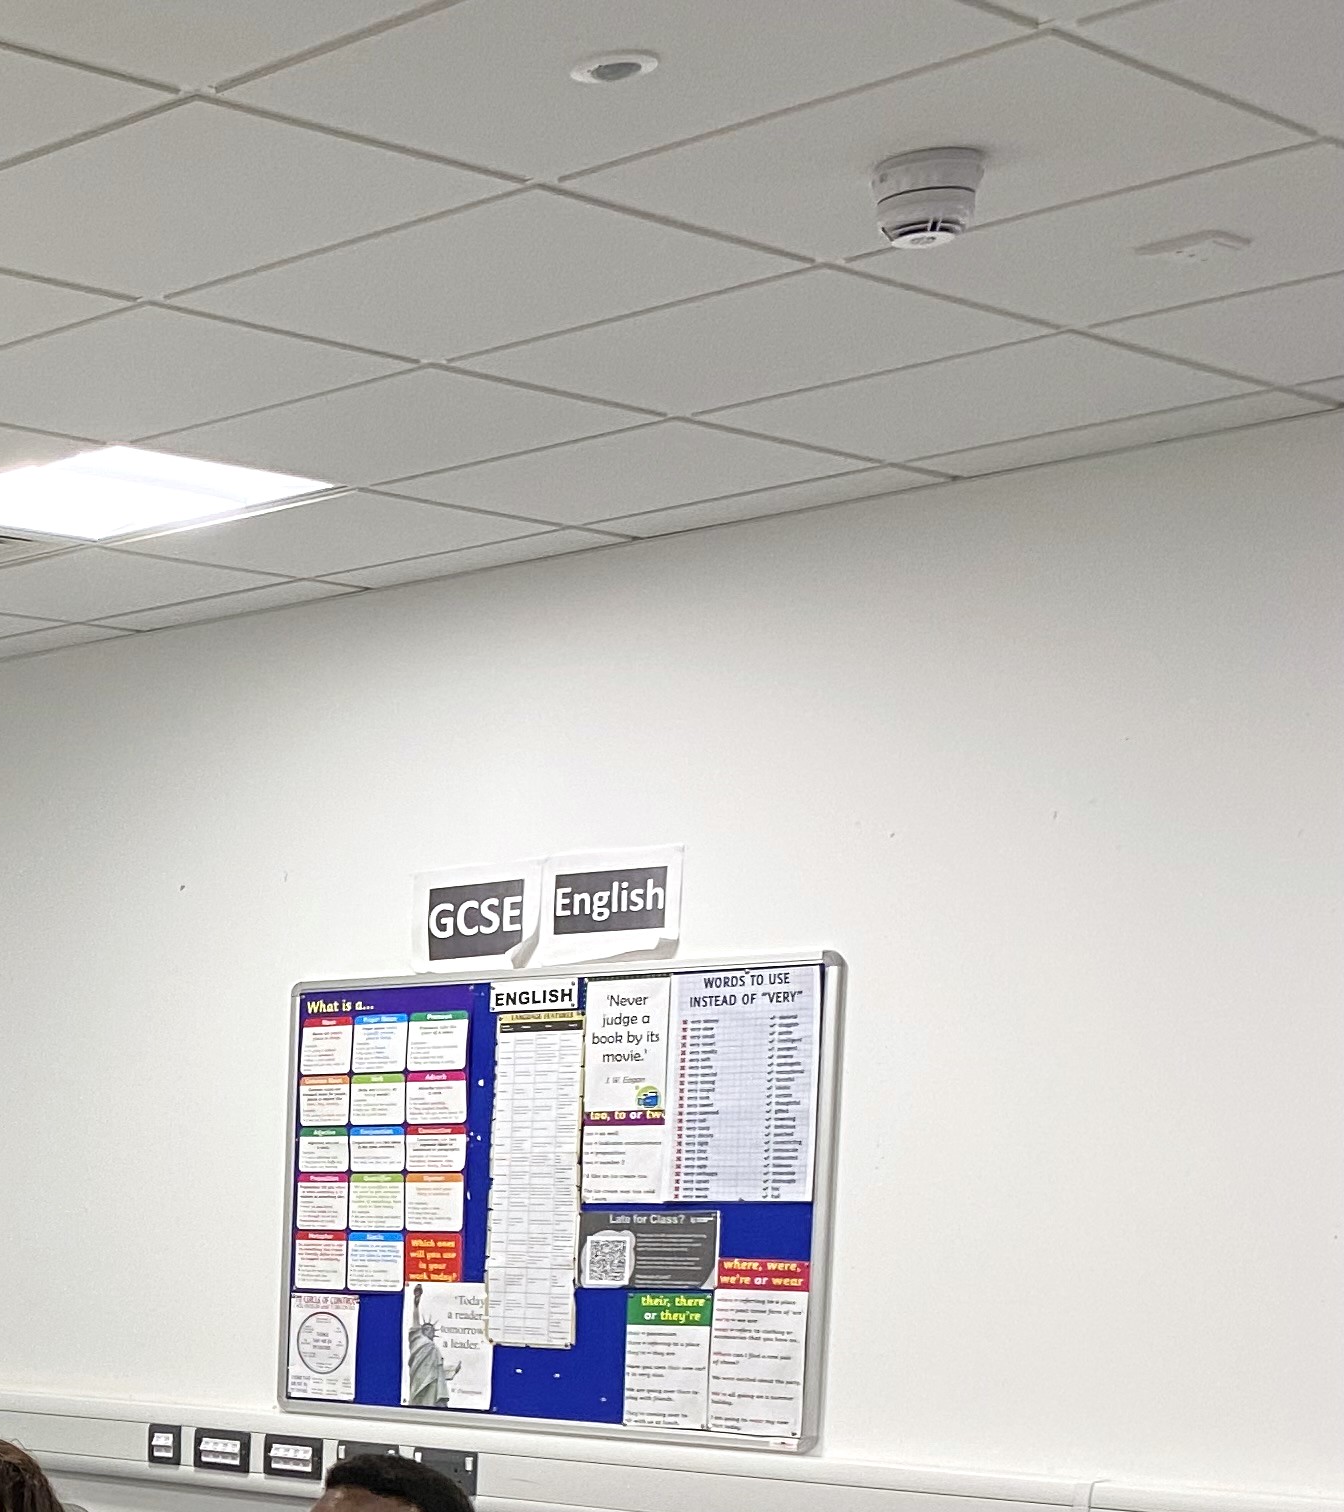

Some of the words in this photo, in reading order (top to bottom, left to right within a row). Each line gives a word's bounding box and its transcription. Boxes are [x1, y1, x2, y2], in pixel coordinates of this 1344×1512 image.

[556, 878, 664, 922] English
[429, 896, 522, 939] GCSE
[703, 976, 745, 989] WORDS
[750, 974, 763, 985] TO
[768, 972, 791, 985] USE
[495, 988, 573, 1006] ENGLISH
[607, 994, 649, 1007] 'Never
[690, 995, 736, 1008] INSTEAD
[742, 993, 757, 1005] OF
[307, 1001, 339, 1014] What
[342, 1000, 352, 1011] is
[602, 1015, 638, 1027] judge
[642, 1014, 650, 1024] a
[592, 1033, 622, 1044] book
[627, 1031, 643, 1045] by
[647, 1031, 660, 1042] its
[602, 1049, 647, 1062] movie.'
[590, 1112, 610, 1121] too,
[615, 1111, 626, 1119] to
[629, 1111, 642, 1119] or
[609, 1215, 630, 1224] Late
[632, 1215, 647, 1223] for
[650, 1214, 685, 1224] Class?
[411, 1239, 435, 1247] Which
[427, 1252, 441, 1260] you
[419, 1260, 426, 1269] in
[724, 1259, 762, 1271] where,
[766, 1261, 801, 1272] were,
[409, 1272, 428, 1280] work
[720, 1274, 751, 1284] we're
[754, 1275, 768, 1285] or
[771, 1277, 804, 1286] wear
[641, 1295, 671, 1307] their,
[675, 1296, 705, 1307] there
[644, 1312, 657, 1320] or
[660, 1310, 701, 1323] they're
